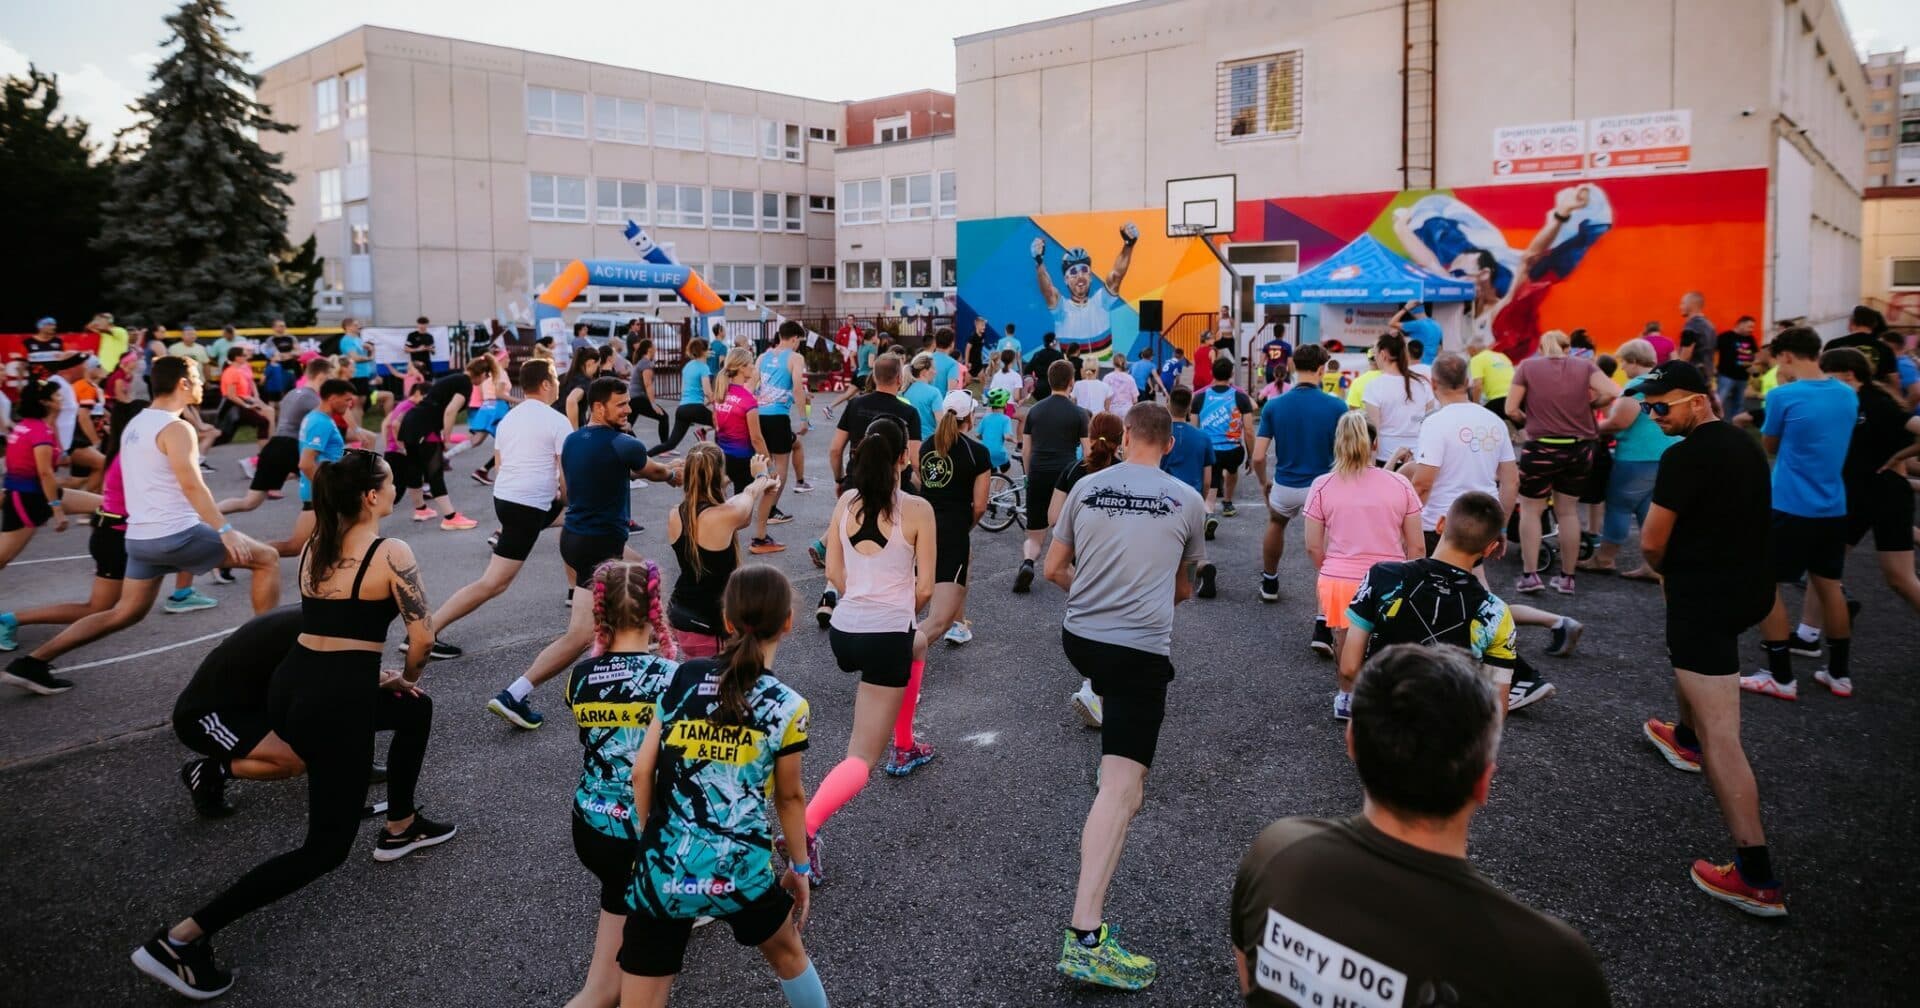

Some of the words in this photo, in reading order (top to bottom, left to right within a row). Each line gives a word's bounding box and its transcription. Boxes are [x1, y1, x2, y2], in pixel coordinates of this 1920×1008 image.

[594, 266, 647, 282] ACTIVE
[654, 272, 681, 285] LIFE
[1095, 497, 1127, 507] HERO
[1130, 499, 1160, 510] TEAM
[611, 662, 626, 670] DOG
[576, 707, 618, 723] ÁRKA
[621, 710, 630, 722] &
[698, 743, 708, 758] &
[581, 798, 631, 820] skaffed
[662, 877, 735, 895] skaffed
[1271, 921, 1330, 975] Every
[1340, 957, 1393, 1001] DOG
[1289, 970, 1307, 997] be
[1312, 992, 1323, 1007] a
